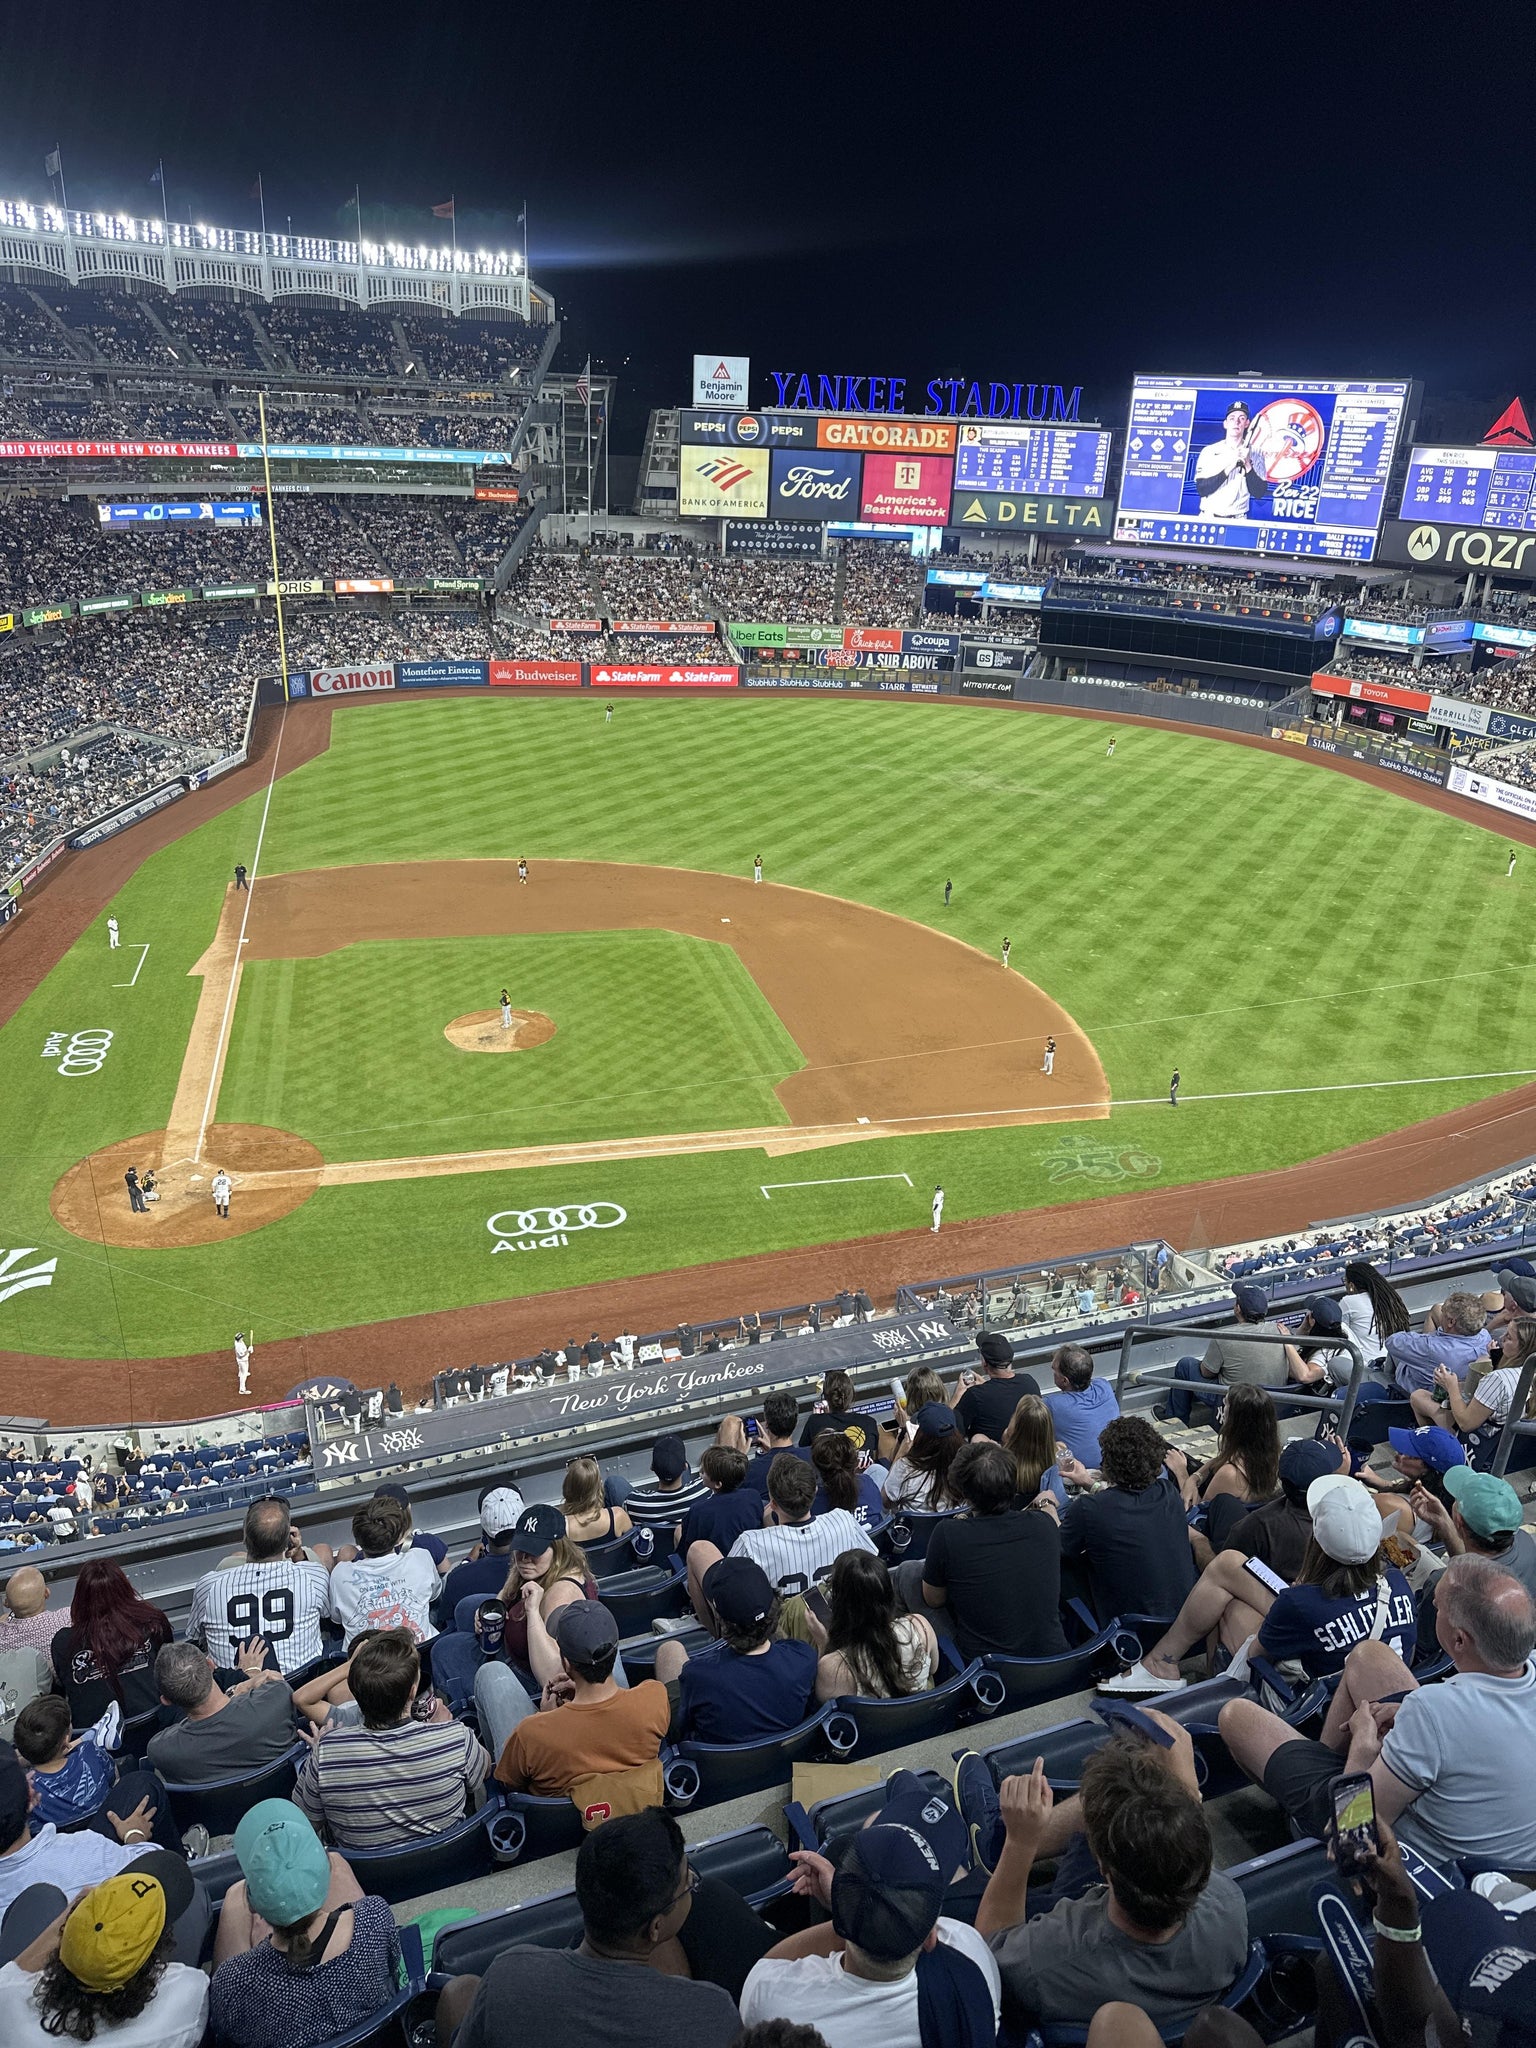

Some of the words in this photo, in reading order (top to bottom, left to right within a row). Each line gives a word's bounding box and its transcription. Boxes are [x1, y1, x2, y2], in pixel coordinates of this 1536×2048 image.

[700, 381, 742, 391] Benjamin
[705, 391, 735, 401] Moore
[771, 372, 906, 414] YANKEE
[925, 379, 1083, 422] STADIUM
[694, 422, 726, 432] PEPSI
[771, 425, 803, 436] PEPSI
[826, 424, 949, 447] GATORADE
[29, 444, 73, 455] VEHICLE
[76, 444, 91, 455] OF
[95, 444, 116, 455] THE
[120, 445, 144, 455] NEW
[148, 444, 178, 455] YORK
[181, 445, 230, 455] YANKEES
[1418, 475, 1433, 483] .279
[1420, 467, 1434, 475] AVG
[1468, 470, 1479, 478] RBI
[779, 466, 852, 500] Ford
[1084, 486, 1098, 494] 9:11
[1273, 480, 1300, 497] Ben
[1300, 486, 1320, 500] 22
[487, 491, 518, 499] Budweiser
[1462, 489, 1476, 497] OPS
[682, 498, 707, 507] BANK
[709, 499, 721, 507] OF
[723, 500, 765, 508] AMERICA
[864, 503, 892, 515] Best
[894, 505, 946, 517] Network
[1273, 499, 1317, 519] RICE
[998, 501, 1102, 527] DELTA
[1142, 521, 1154, 529] PIT
[1174, 523, 1180, 531] 0
[1183, 524, 1189, 532] 3
[1201, 525, 1207, 533] 0
[1297, 533, 1303, 541] 3
[1140, 531, 1155, 540] NYY
[1191, 535, 1197, 543] 4
[1209, 536, 1214, 544] 0
[1270, 541, 1276, 549] 9
[1445, 531, 1536, 569] razr
[433, 580, 456, 590] Poland
[456, 580, 480, 591] Spring
[147, 593, 187, 605] freshdirect
[758, 631, 783, 642] Eats
[923, 637, 949, 647] coupa
[866, 653, 873, 667] A
[877, 653, 899, 668] SUB
[903, 655, 938, 669] ABOVE
[979, 654, 991, 662] GS
[402, 667, 447, 677] Montefiore
[448, 665, 481, 675] Einstein
[515, 669, 577, 681] Budweiser
[312, 669, 393, 693] Canon
[747, 678, 778, 687] StubHub
[779, 679, 810, 688] StubHub
[812, 679, 843, 688] StubHub
[879, 683, 906, 691] STARR
[962, 680, 1012, 692] NITTOTIRE.COM
[1363, 688, 1389, 699] TOYOTA
[1431, 707, 1466, 721] MERRILL
[1411, 721, 1433, 731] ARENA
[1312, 738, 1337, 752] STARR
[1379, 759, 1402, 771] StubHub
[1401, 765, 1422, 778] StubHub
[1422, 772, 1443, 785] StubHub
[40, 1031, 69, 1057] Audi
[490, 1233, 569, 1254] Audi
[872, 1328, 902, 1341] NEW
[917, 1321, 950, 1340] NY
[872, 1334, 911, 1349] YORK
[550, 1394, 608, 1415] New
[608, 1375, 670, 1412] York
[670, 1362, 765, 1398] Yankees
[382, 1428, 418, 1443] NEW
[1414, 1425, 1431, 1435] NY
[379, 1434, 424, 1454] YORK
[322, 1440, 360, 1467] NY
[523, 1516, 538, 1532] NY
[369, 1583, 388, 1591] STAGE
[391, 1579, 406, 1587] WITH
[227, 1587, 294, 1648] 99
[1314, 1595, 1414, 1652] SCHLITLER
[585, 1802, 611, 1822] C
[909, 1833, 940, 1870] NEW
[131, 1879, 156, 1898] P
